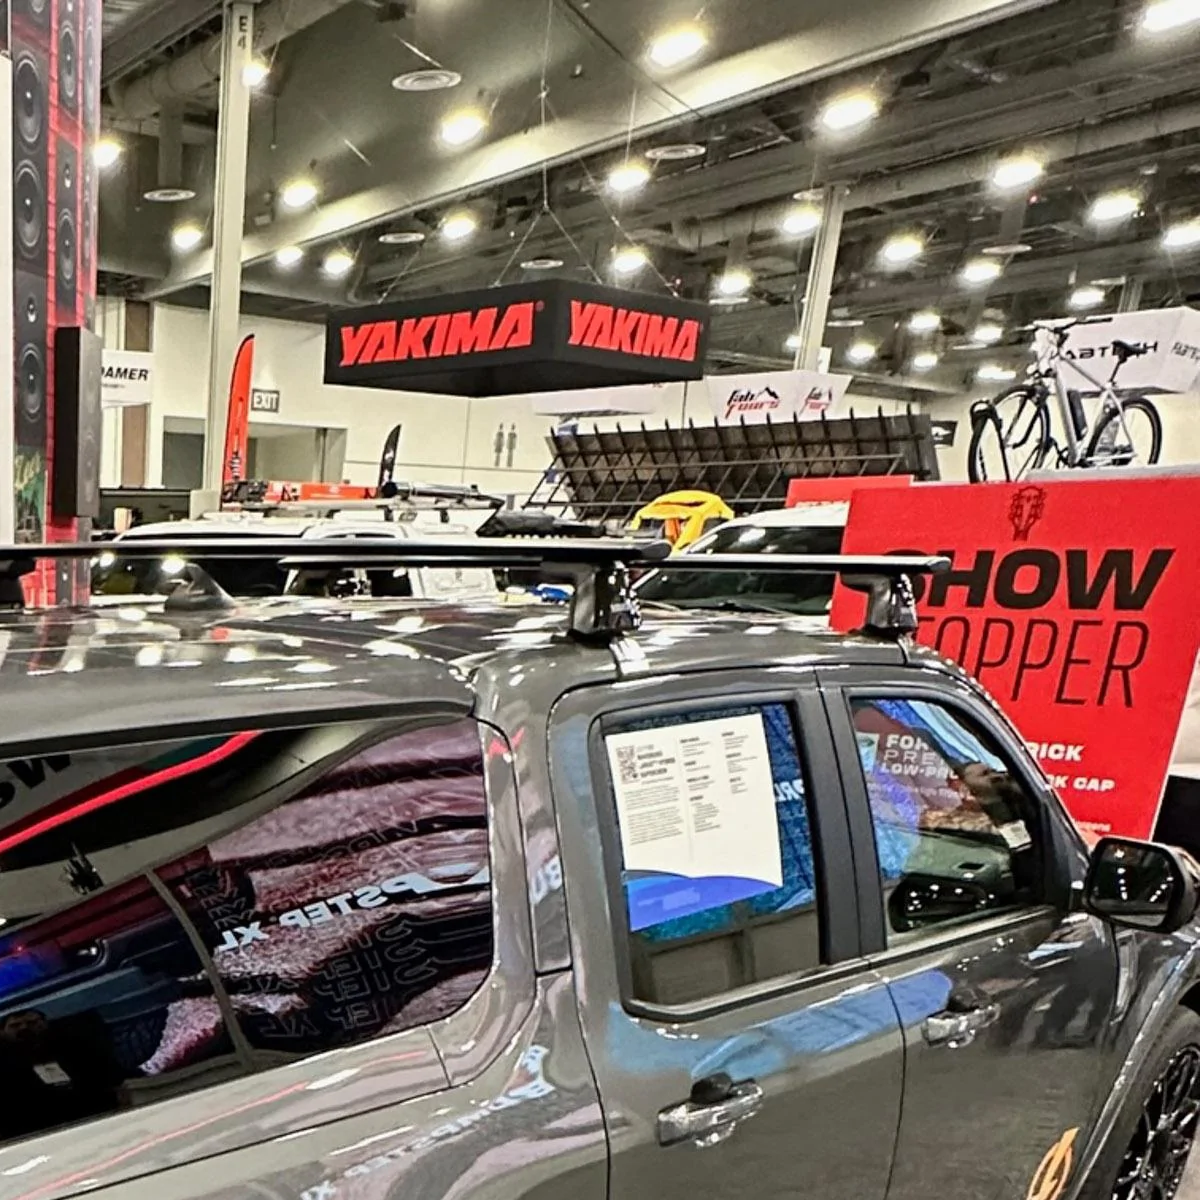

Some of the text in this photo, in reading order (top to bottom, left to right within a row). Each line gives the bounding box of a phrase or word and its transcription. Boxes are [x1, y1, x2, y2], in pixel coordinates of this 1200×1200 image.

[340, 302, 534, 367] YAKIMA
[568, 300, 699, 362] YAKIMA
[253, 391, 279, 409] EXIT
[885, 548, 1176, 610] HOW
[914, 616, 1149, 708] OPPER
[1073, 775, 1115, 792] CAP
